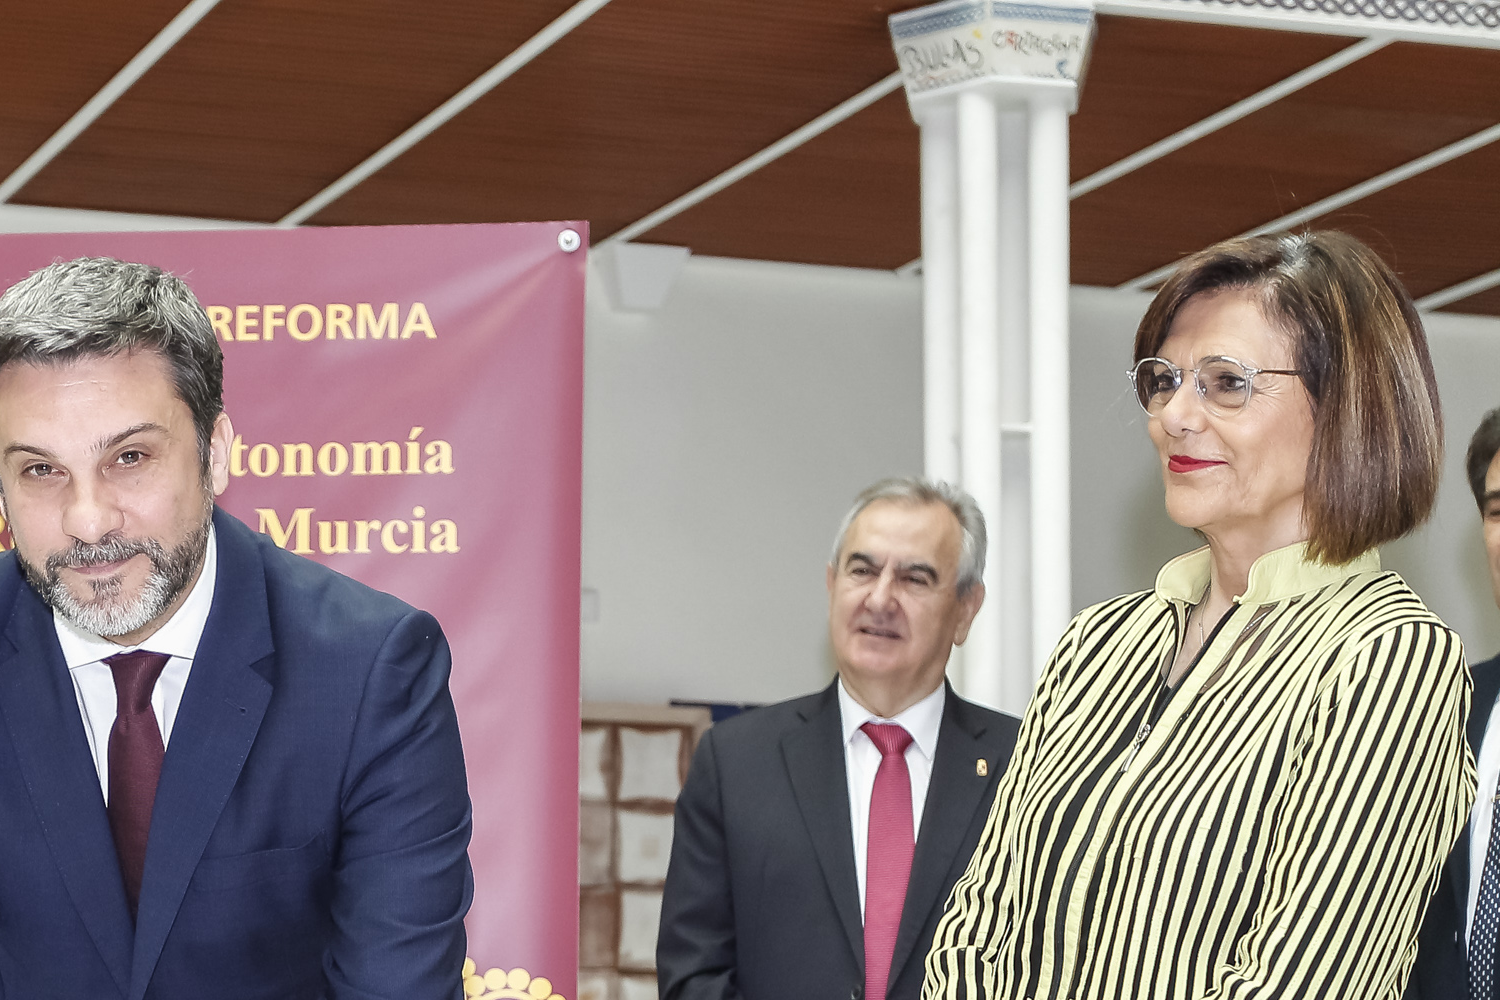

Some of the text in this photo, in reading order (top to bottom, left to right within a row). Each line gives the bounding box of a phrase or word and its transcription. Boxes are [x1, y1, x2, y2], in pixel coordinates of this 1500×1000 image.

[204, 302, 439, 343] REFORMA
[228, 426, 456, 478] tonomía
[255, 505, 462, 555] Murcia
